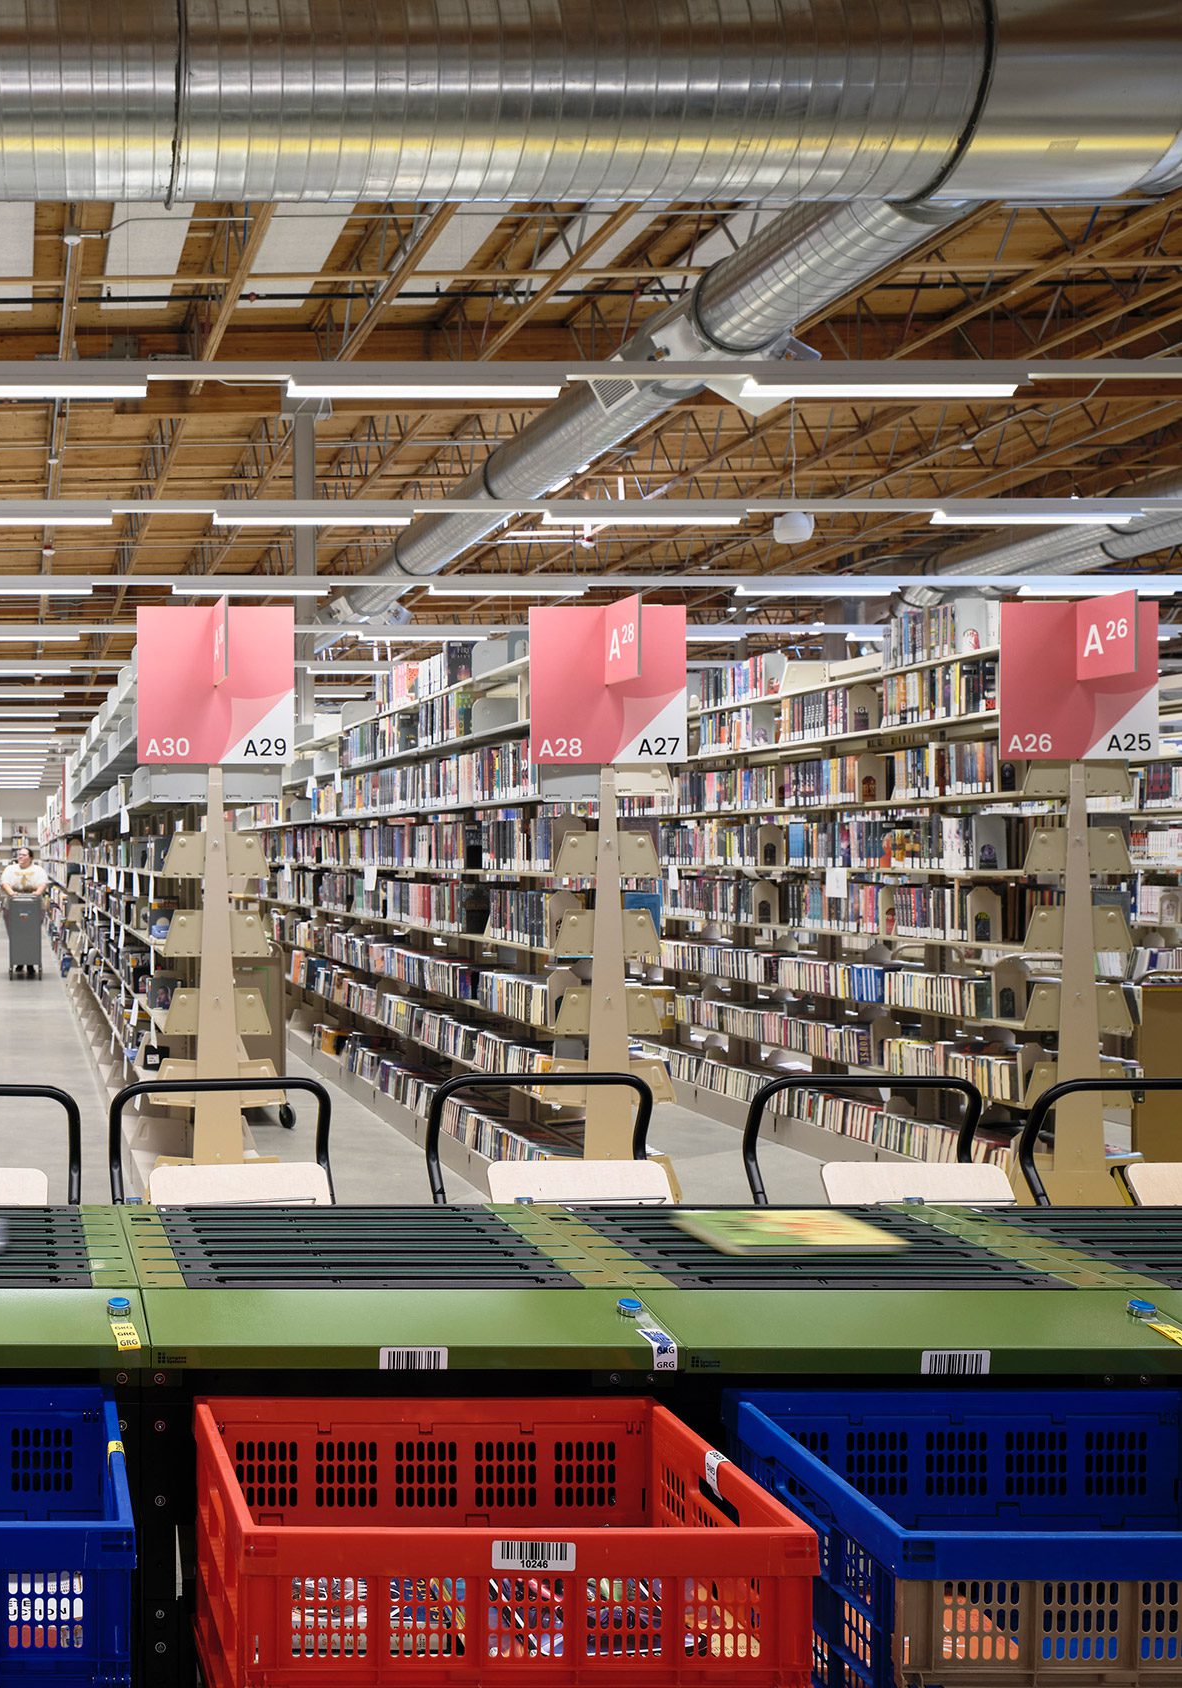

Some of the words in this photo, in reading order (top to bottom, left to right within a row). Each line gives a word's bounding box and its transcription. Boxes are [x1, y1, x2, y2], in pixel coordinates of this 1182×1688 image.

[608, 622, 635, 662] A28
[1083, 617, 1128, 658] A26
[145, 737, 190, 757] A30
[243, 738, 287, 757] A29
[538, 737, 583, 758] A28
[638, 737, 680, 756] A27
[1008, 733, 1053, 753] A26
[1106, 733, 1152, 752] A25
[656, 1361, 675, 1369] GRG
[520, 1559, 549, 1569] 10246
